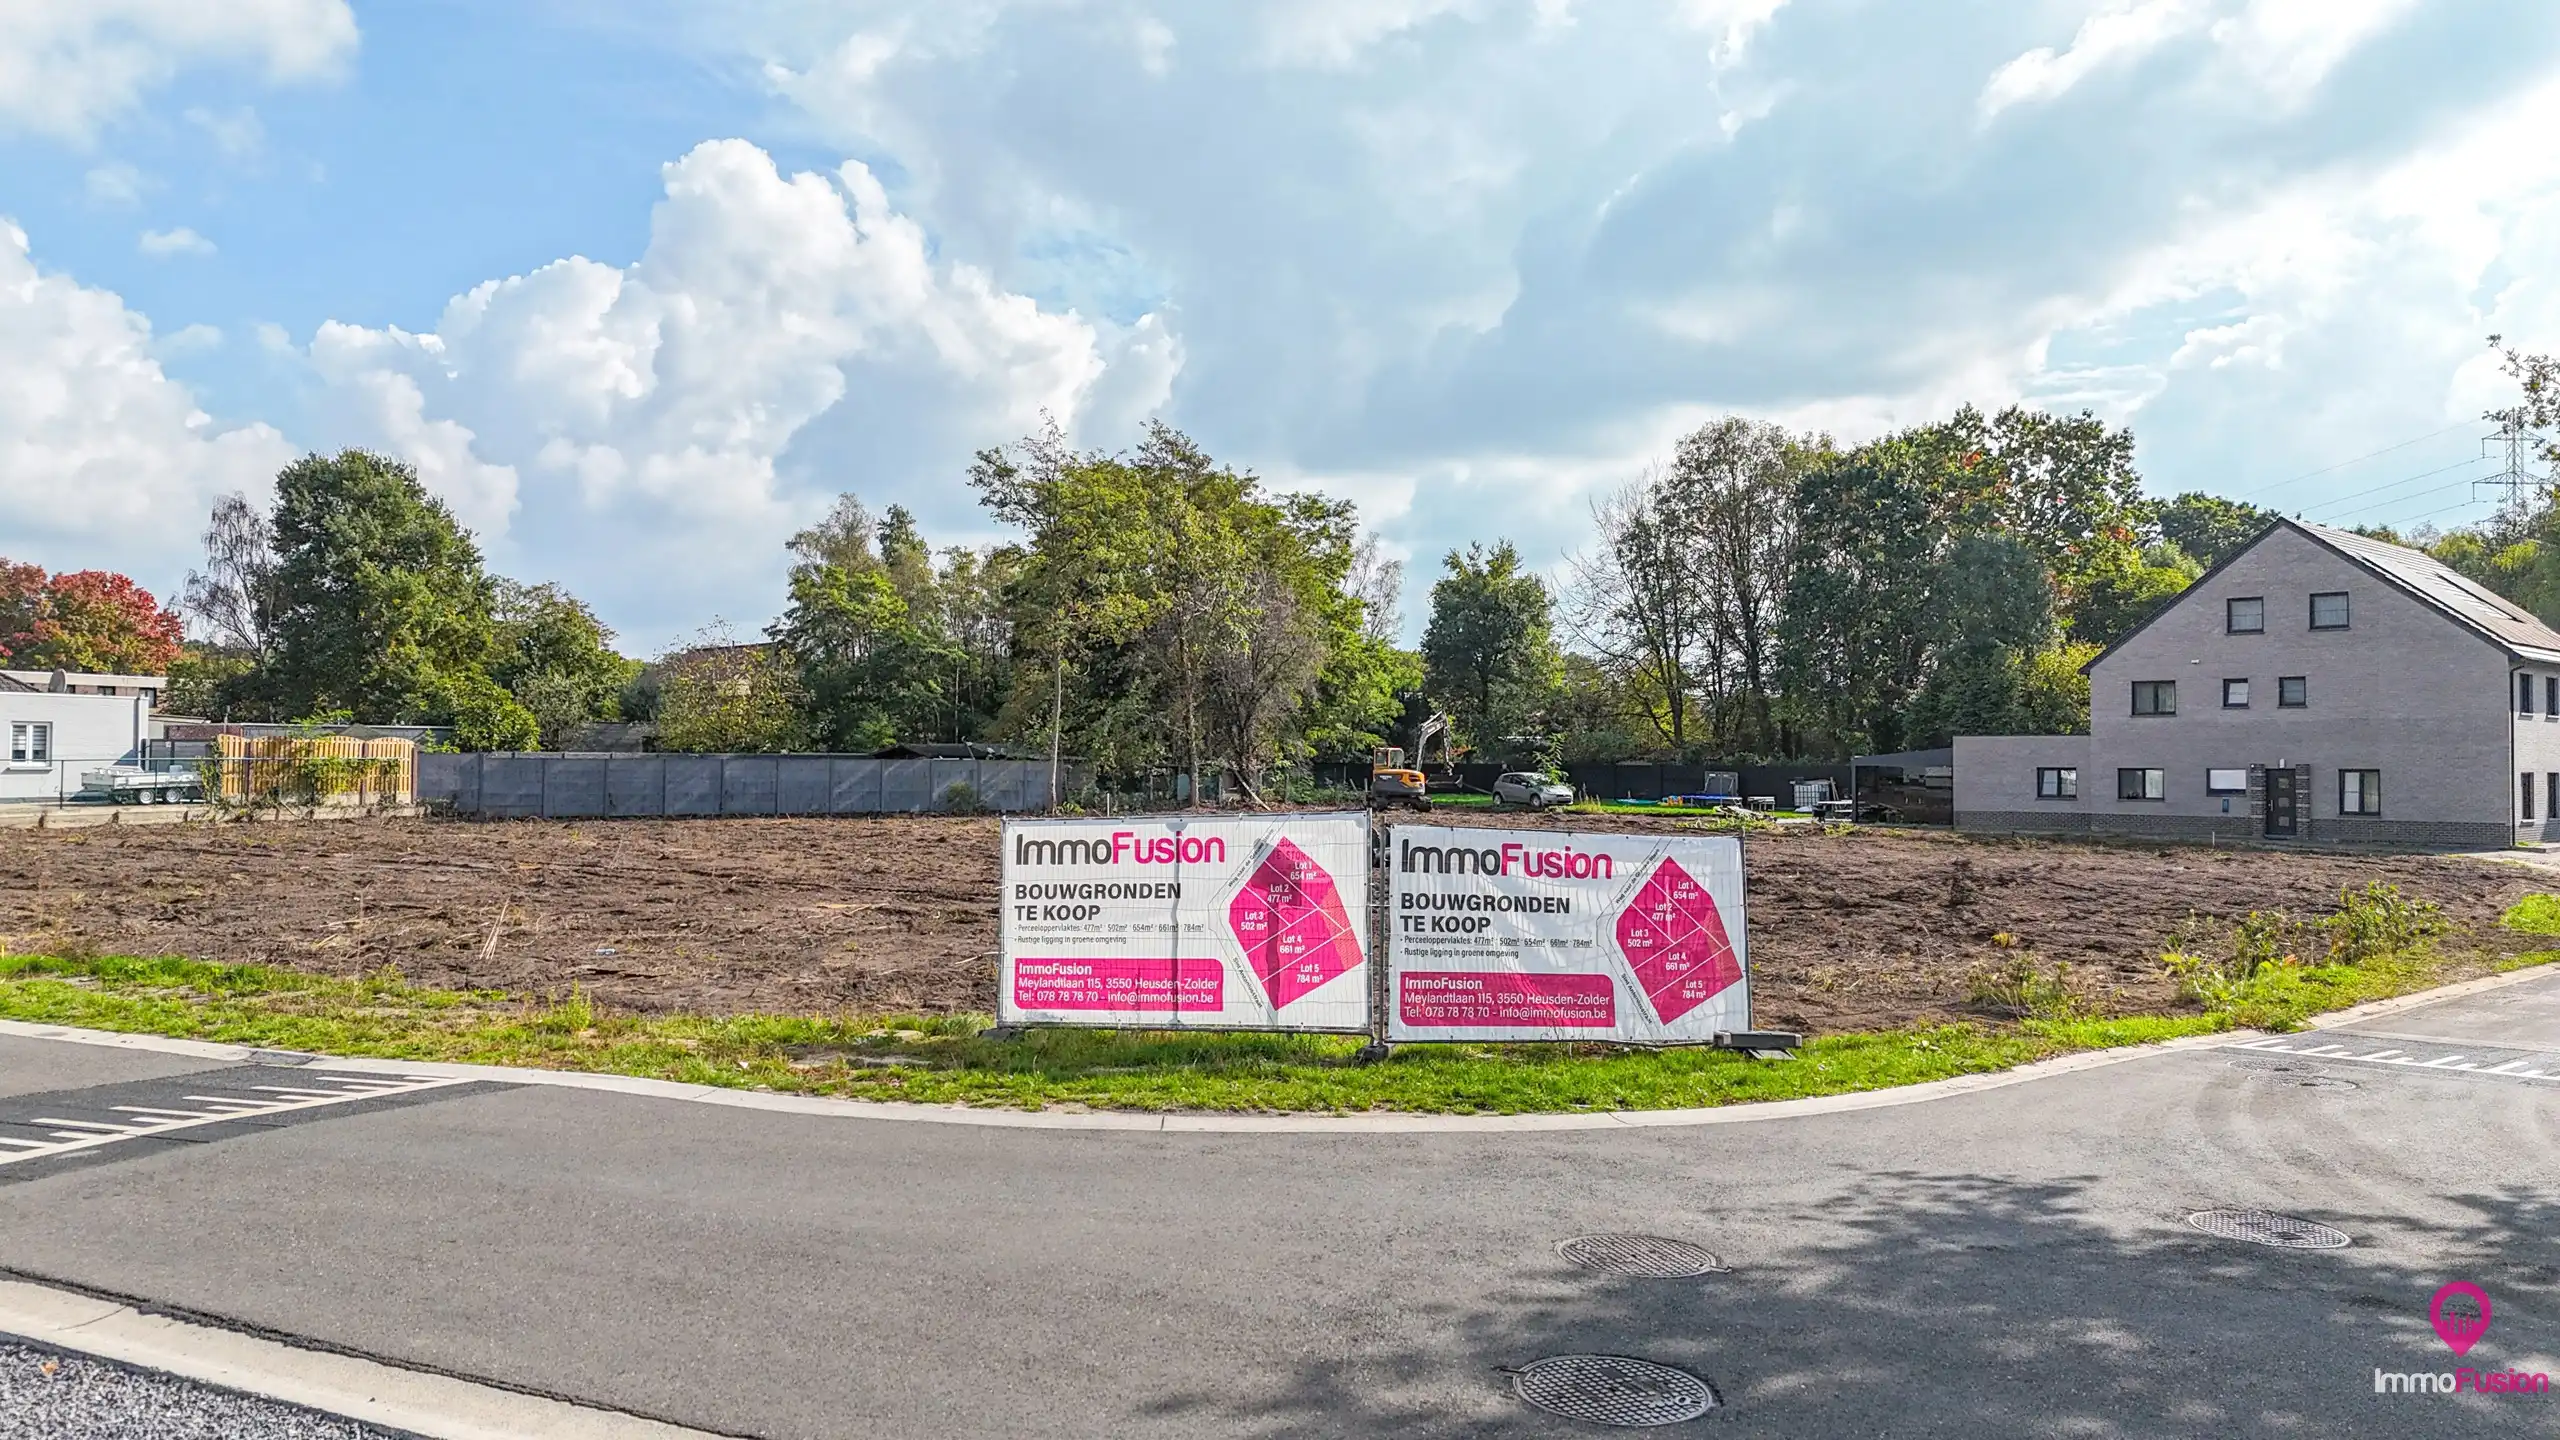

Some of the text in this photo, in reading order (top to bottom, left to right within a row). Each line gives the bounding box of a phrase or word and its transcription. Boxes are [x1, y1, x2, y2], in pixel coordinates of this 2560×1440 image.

[1015, 831, 1225, 865] ImmoFusion
[1401, 839, 1613, 879] ImmoFusion
[1294, 861, 1313, 870] Lot 1
[1290, 872, 1304, 880] 654
[1270, 884, 1289, 893] Lot 2
[1678, 881, 1694, 890] Lot 1
[1015, 883, 1181, 900] BOUWGRONDEN
[1673, 892, 1687, 900] 654
[1267, 895, 1280, 903] 477
[1401, 893, 1570, 913] BOUWGRONDEN
[1655, 903, 1672, 911] Lot 2
[1015, 904, 1100, 921] TE KOOP
[1244, 911, 1264, 920] Lot 3
[1652, 913, 1664, 921] 477
[1241, 922, 1255, 930] 502
[1400, 916, 1491, 933] TE KOOP
[1631, 928, 1649, 937] Lot 3
[1018, 936, 1040, 944] Rustige
[1041, 936, 1063, 944] ligging
[1282, 935, 1302, 943] Lot 4
[1405, 936, 1472, 945] Perceeloppervlaktes:
[1627, 939, 1641, 947] 502
[1280, 945, 1293, 954] 661
[1404, 948, 1428, 957] Rustige
[1430, 949, 1452, 958] ligging
[1461, 950, 1484, 959] groene
[1485, 950, 1519, 959] omgeving
[1668, 952, 1686, 961] Lot 4
[1019, 963, 1092, 975] ImmoFusion
[1301, 964, 1319, 972] Lot 5
[1665, 962, 1678, 970] 661
[1297, 975, 1310, 983] 784
[1405, 977, 1483, 990] ImmoFusion
[1019, 978, 1219, 990] Meylandtlaan 115, 3550 Heusden-Zolder
[1685, 980, 1703, 989] Lot 5
[1018, 990, 1034, 1001] Tel:
[1037, 991, 1055, 1001] 078
[1057, 991, 1069, 1001] 78
[1072, 991, 1084, 1001] 78
[1086, 991, 1098, 1001] 70
[1107, 991, 1214, 1004] info@immofusion.be
[1682, 990, 1695, 998] 784
[1405, 993, 1609, 1006] Meylandtlaan 115, 3550 Heusden-Zolder
[1405, 1007, 1421, 1017] Tel:
[1425, 1007, 1444, 1017] 078
[1447, 1007, 1459, 1017] 78
[1462, 1007, 1474, 1017] 78
[1476, 1007, 1490, 1017] 70
[1500, 1007, 1607, 1020] info@immofusion.be
